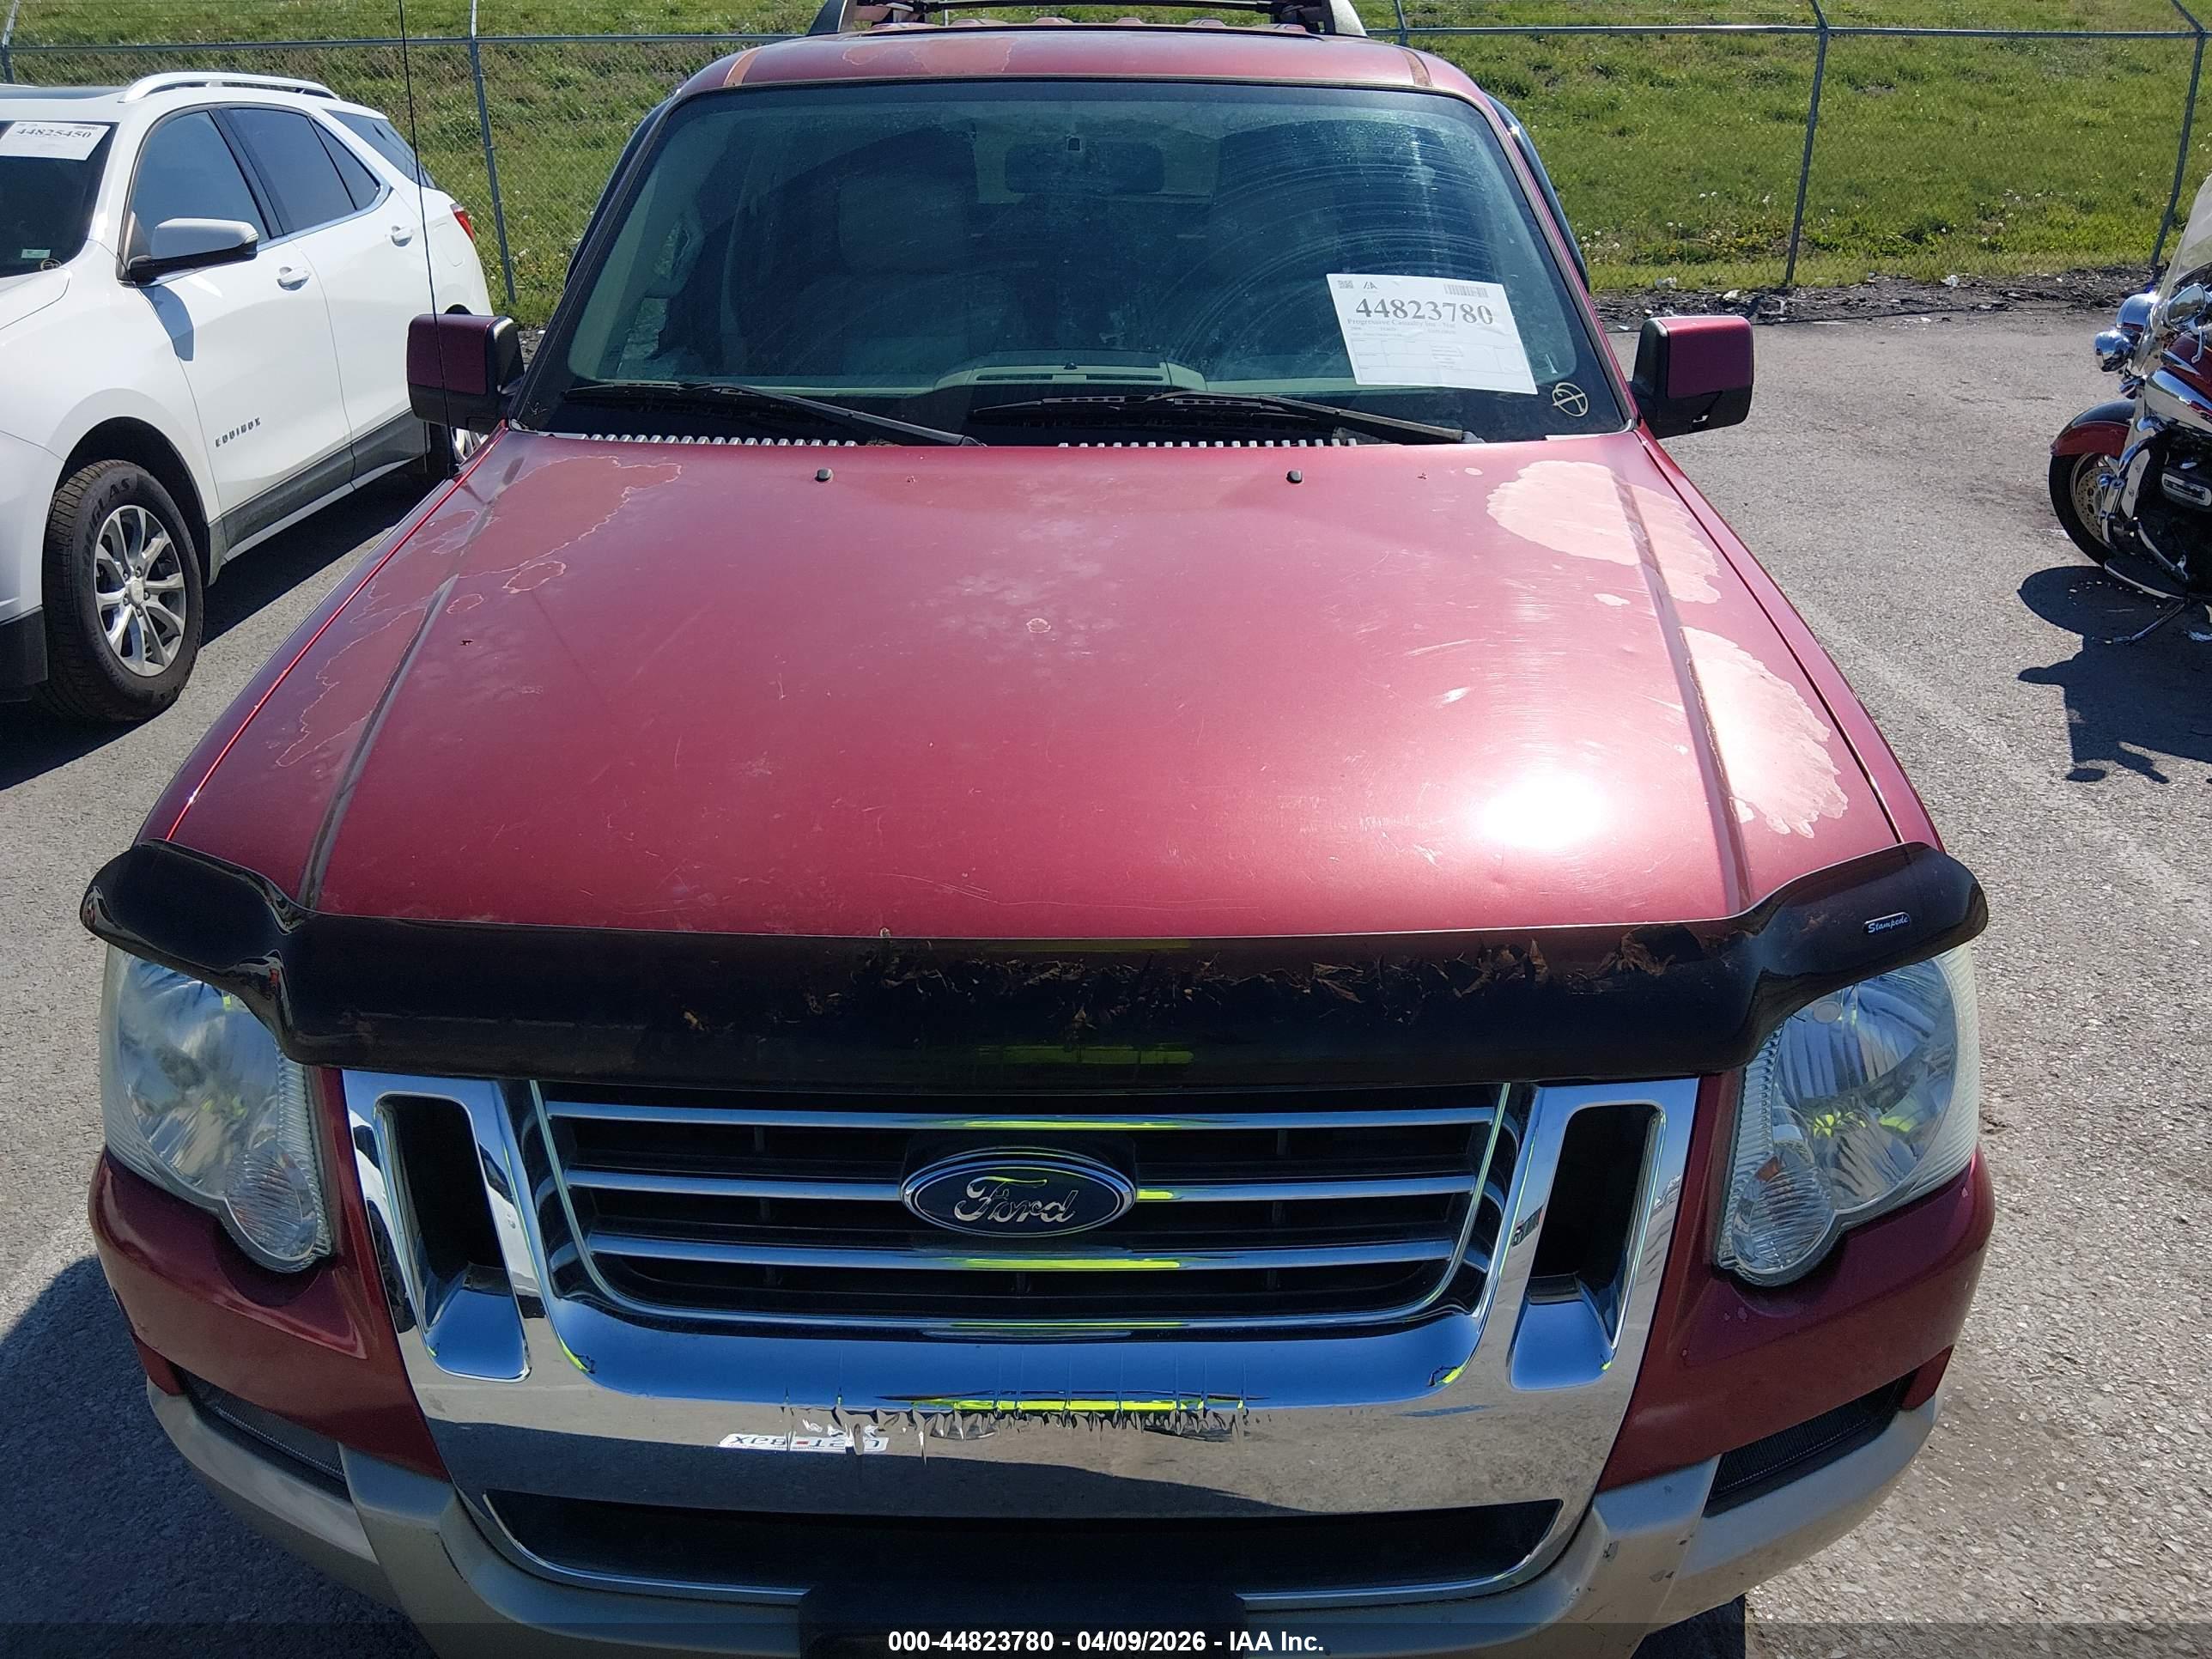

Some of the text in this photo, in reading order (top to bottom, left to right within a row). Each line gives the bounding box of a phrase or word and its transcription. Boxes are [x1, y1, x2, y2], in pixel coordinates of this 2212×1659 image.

[16, 128, 92, 138] 44825450
[1347, 318, 1390, 327] Progressive
[1355, 298, 1493, 325] 44823780
[215, 417, 261, 447] EQUINOX
[1868, 915, 1908, 933] Stampede
[954, 1176, 1079, 1223] Ford
